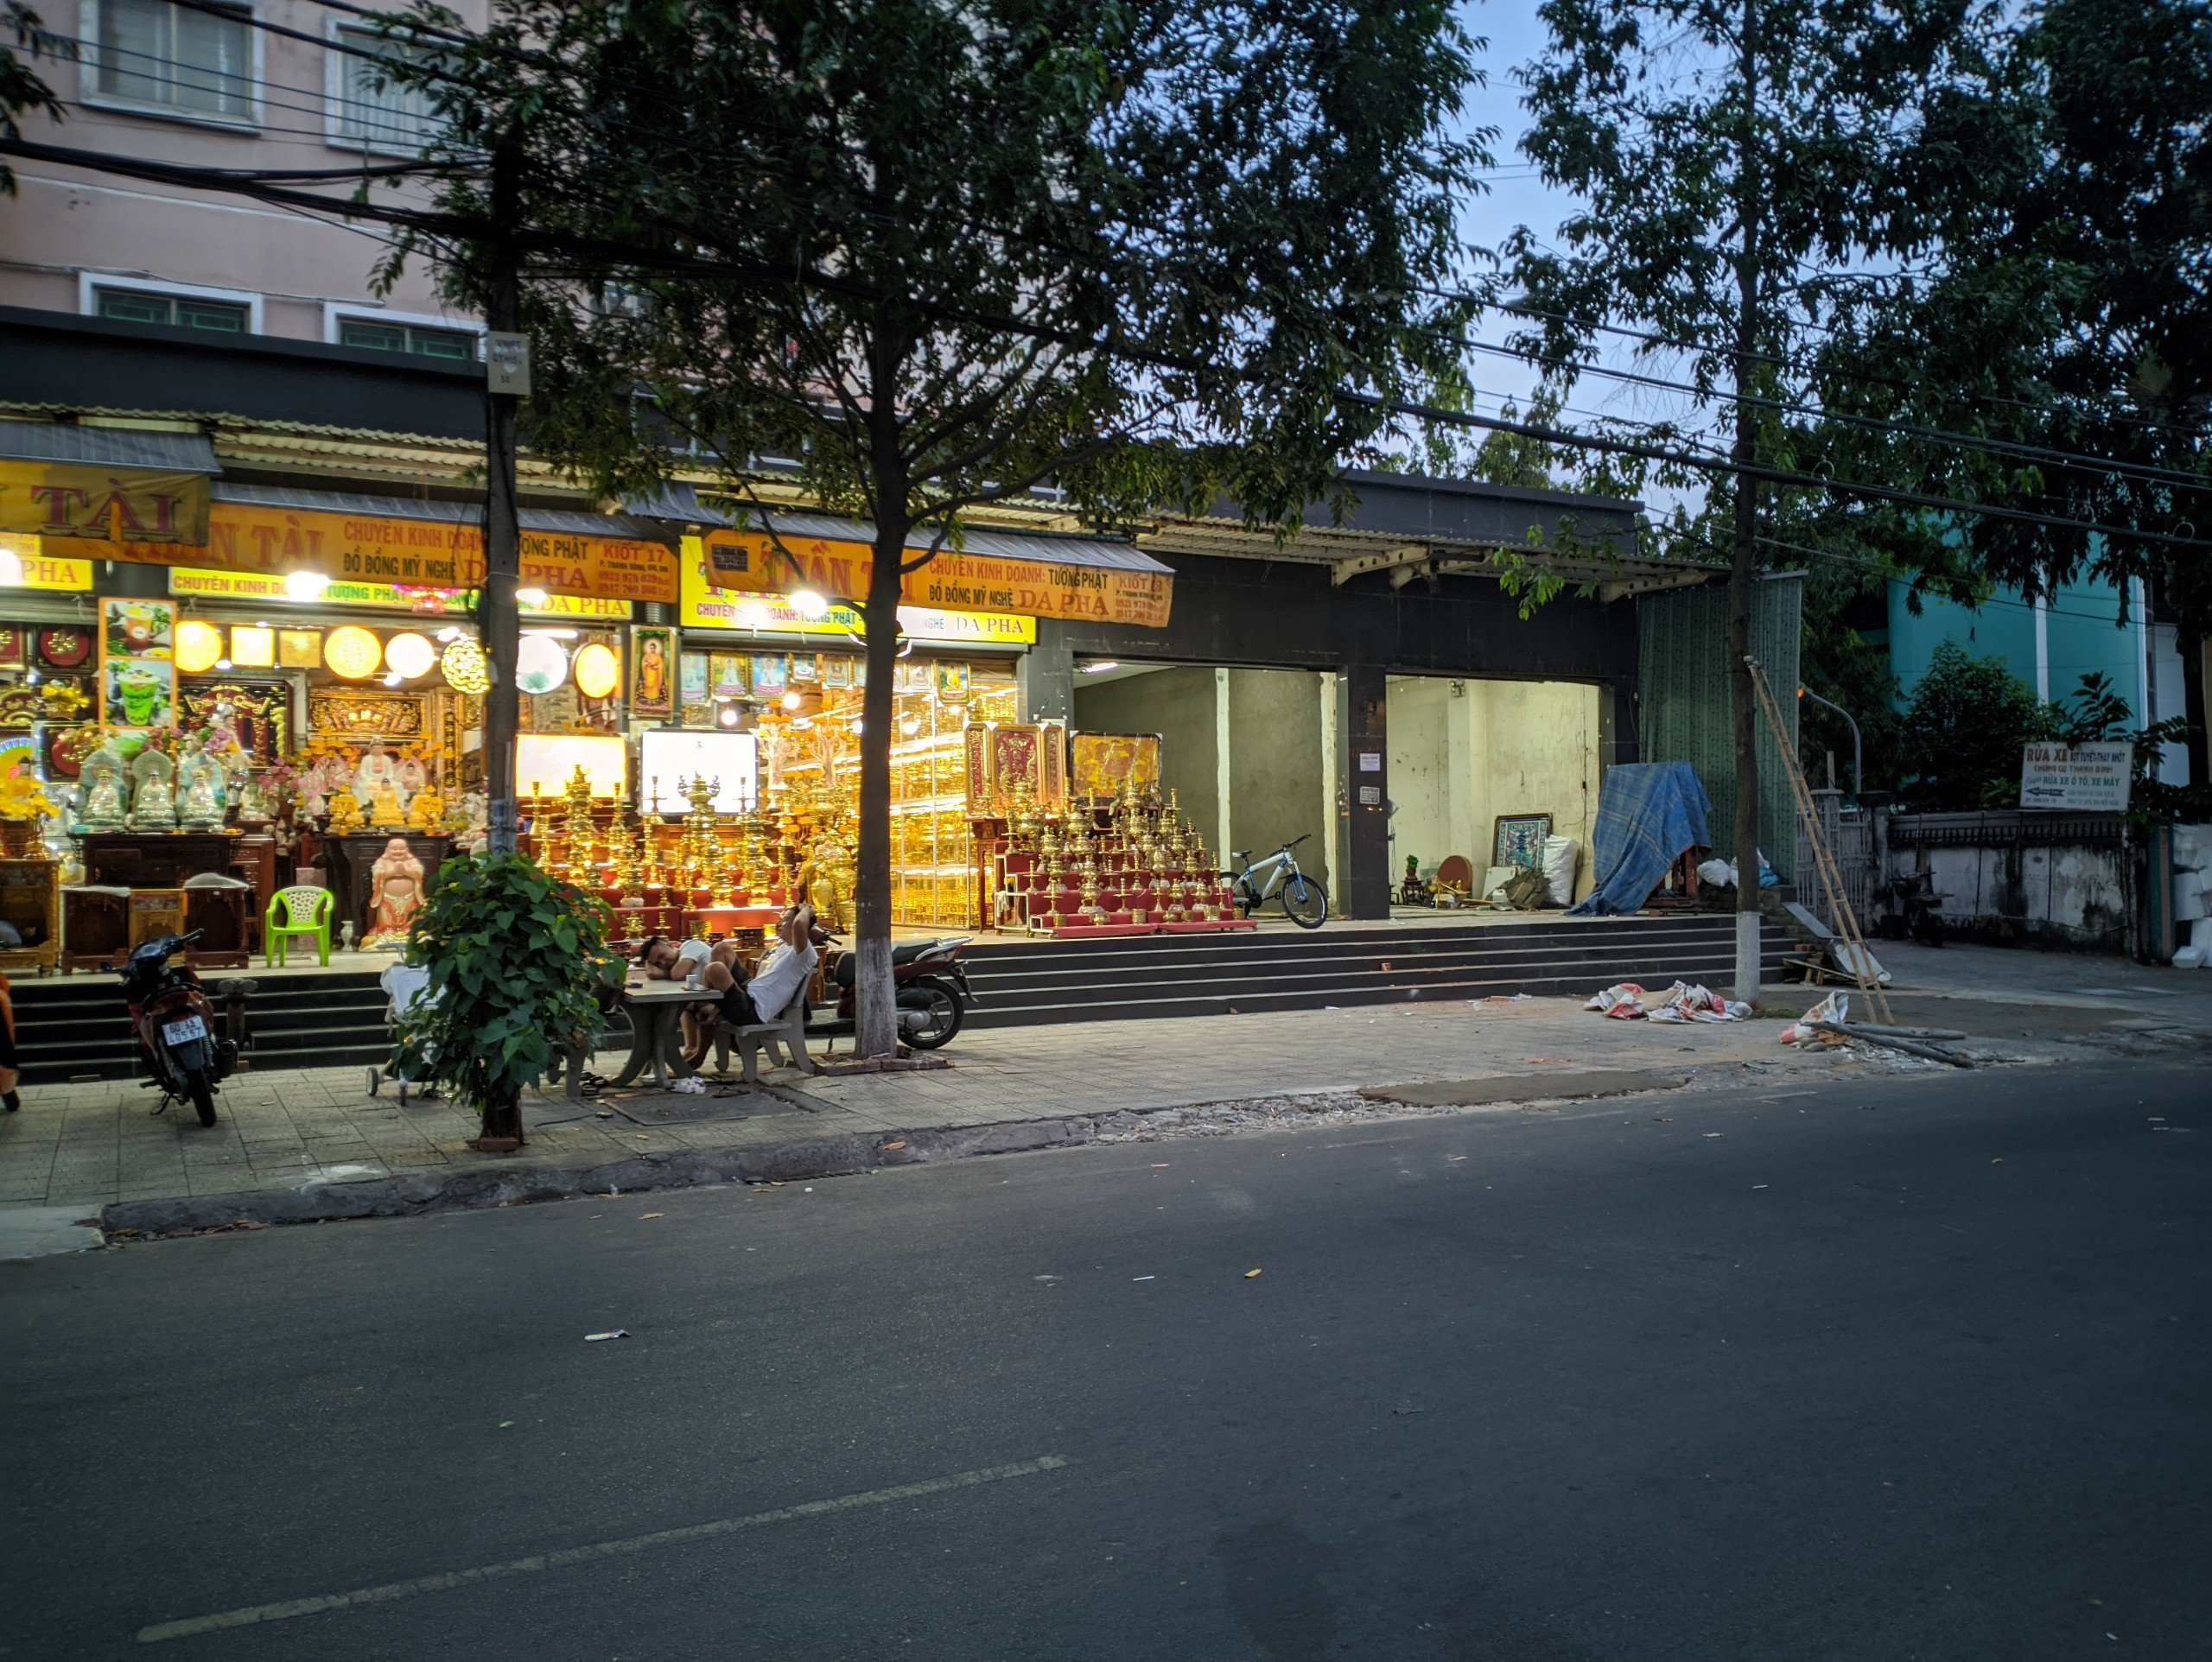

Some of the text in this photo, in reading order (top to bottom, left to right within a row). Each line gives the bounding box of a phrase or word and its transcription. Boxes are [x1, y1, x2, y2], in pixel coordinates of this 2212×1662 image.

[30, 478, 179, 534] TÀI
[250, 514, 324, 569] TÀI
[345, 521, 588, 562] CHUYÊN KINH DOAN ỢNG PHẬT
[344, 545, 589, 589] ĐỒ ĐỒNG MỸ NGHỆ D PHA
[647, 549, 665, 561] 17
[20, 560, 78, 583] PHA
[174, 575, 230, 591] CHUYÊN
[234, 580, 267, 594] KINH
[929, 556, 1109, 593] CHUYÊN KINH DOANH: TƯỢNG PHẬT
[580, 598, 626, 615] PHA
[929, 578, 942, 602] ĐỒ
[945, 580, 970, 604] ĐỒNG
[973, 586, 987, 606] MỸ
[989, 587, 1014, 610] NGHỆ
[1019, 589, 1053, 611] DA
[1059, 593, 1109, 615] PHA
[766, 608, 798, 621] OANH:
[957, 618, 980, 631] DA
[987, 618, 1024, 634] PHA
[2054, 748, 2068, 762] XE
[2060, 777, 2069, 785] XE
[2091, 777, 2101, 786] XE
